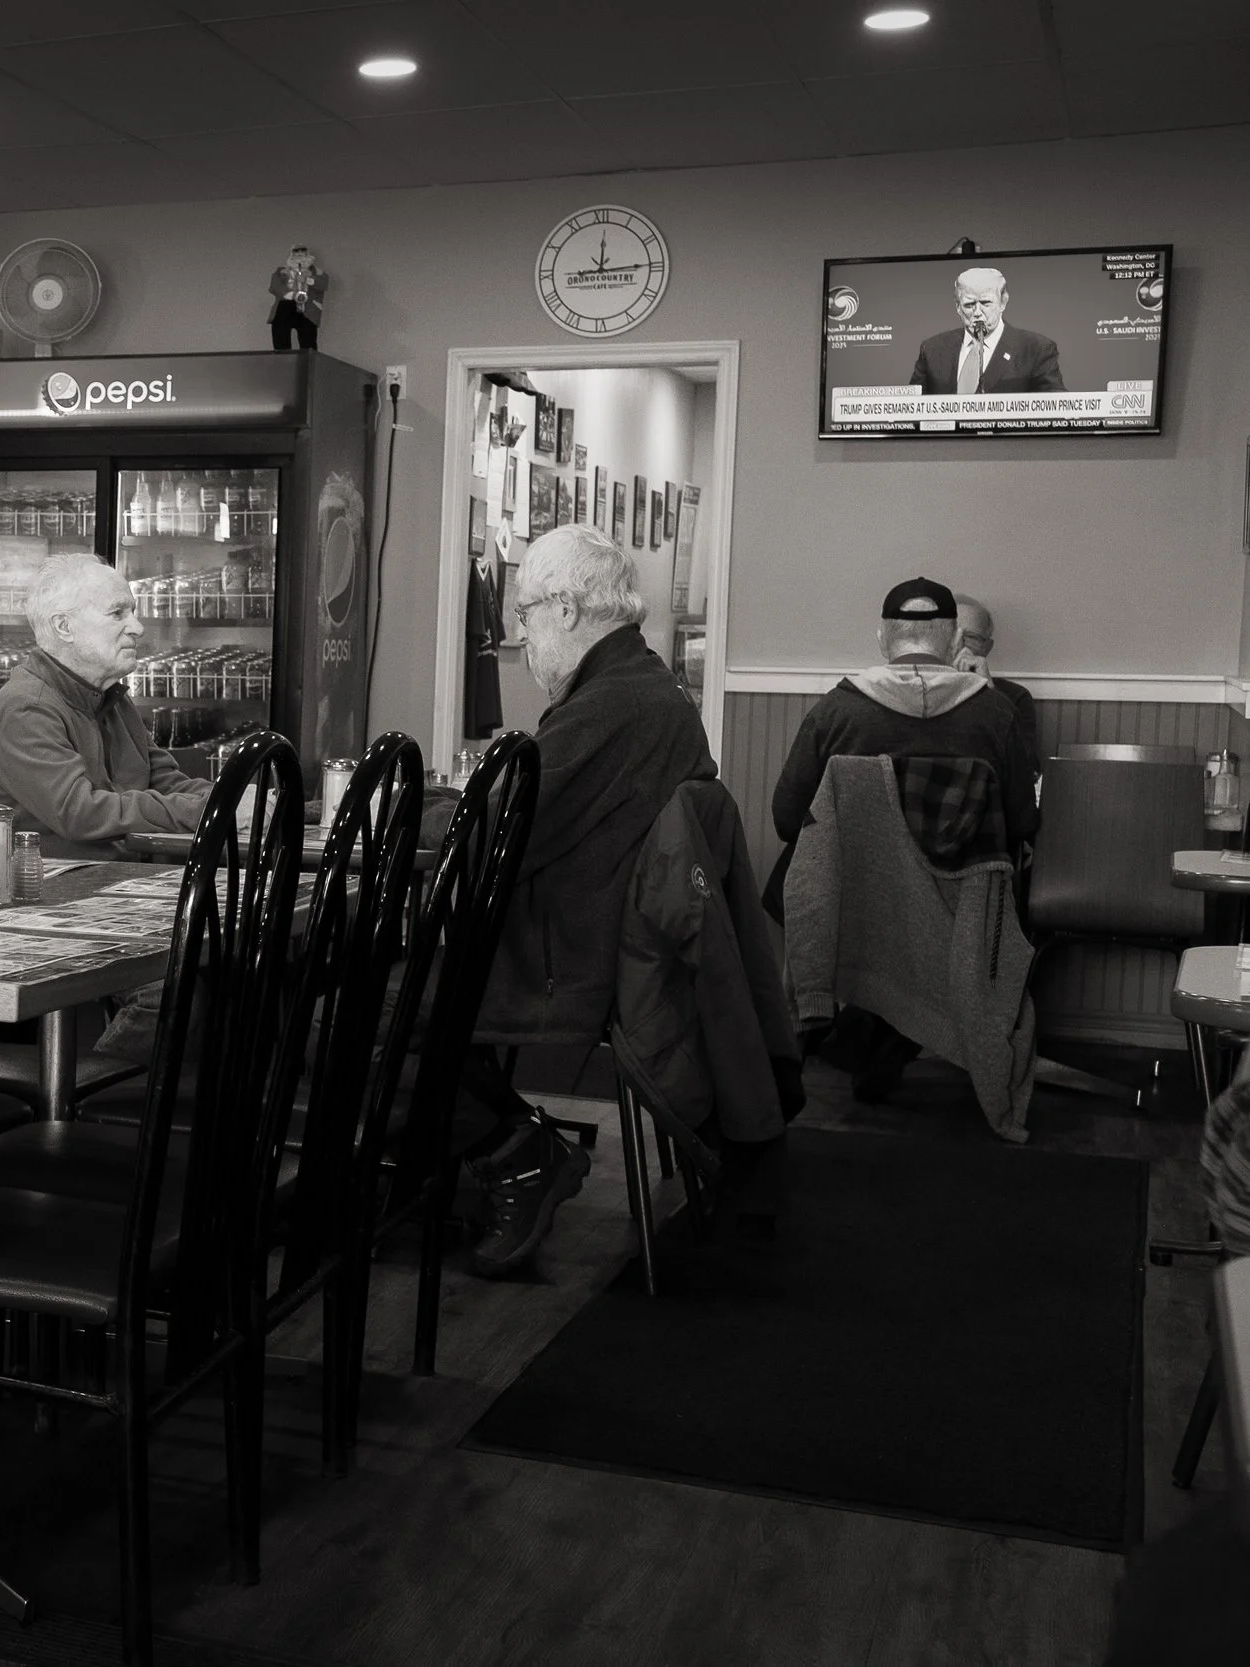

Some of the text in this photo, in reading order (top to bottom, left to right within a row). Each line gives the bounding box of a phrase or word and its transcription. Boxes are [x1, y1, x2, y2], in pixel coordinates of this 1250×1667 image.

[1106, 254, 1134, 262] Kennedy
[85, 374, 174, 411] pepsi
[840, 386, 915, 396] BREAKING NEWS
[1116, 382, 1142, 390] LIVE
[840, 398, 1101, 415] TRUMP GIVES REMARKS AT U.S.-SAUDI FORUM AMID LAVISH CROWN PRINCE VISIT
[1111, 394, 1145, 409] CNN
[959, 422, 996, 430] PRESIDENT
[997, 421, 1026, 429] DONALD
[1027, 420, 1051, 428] TRUMP
[1069, 419, 1100, 427] TUESDAY
[322, 634, 351, 669] pepsi
